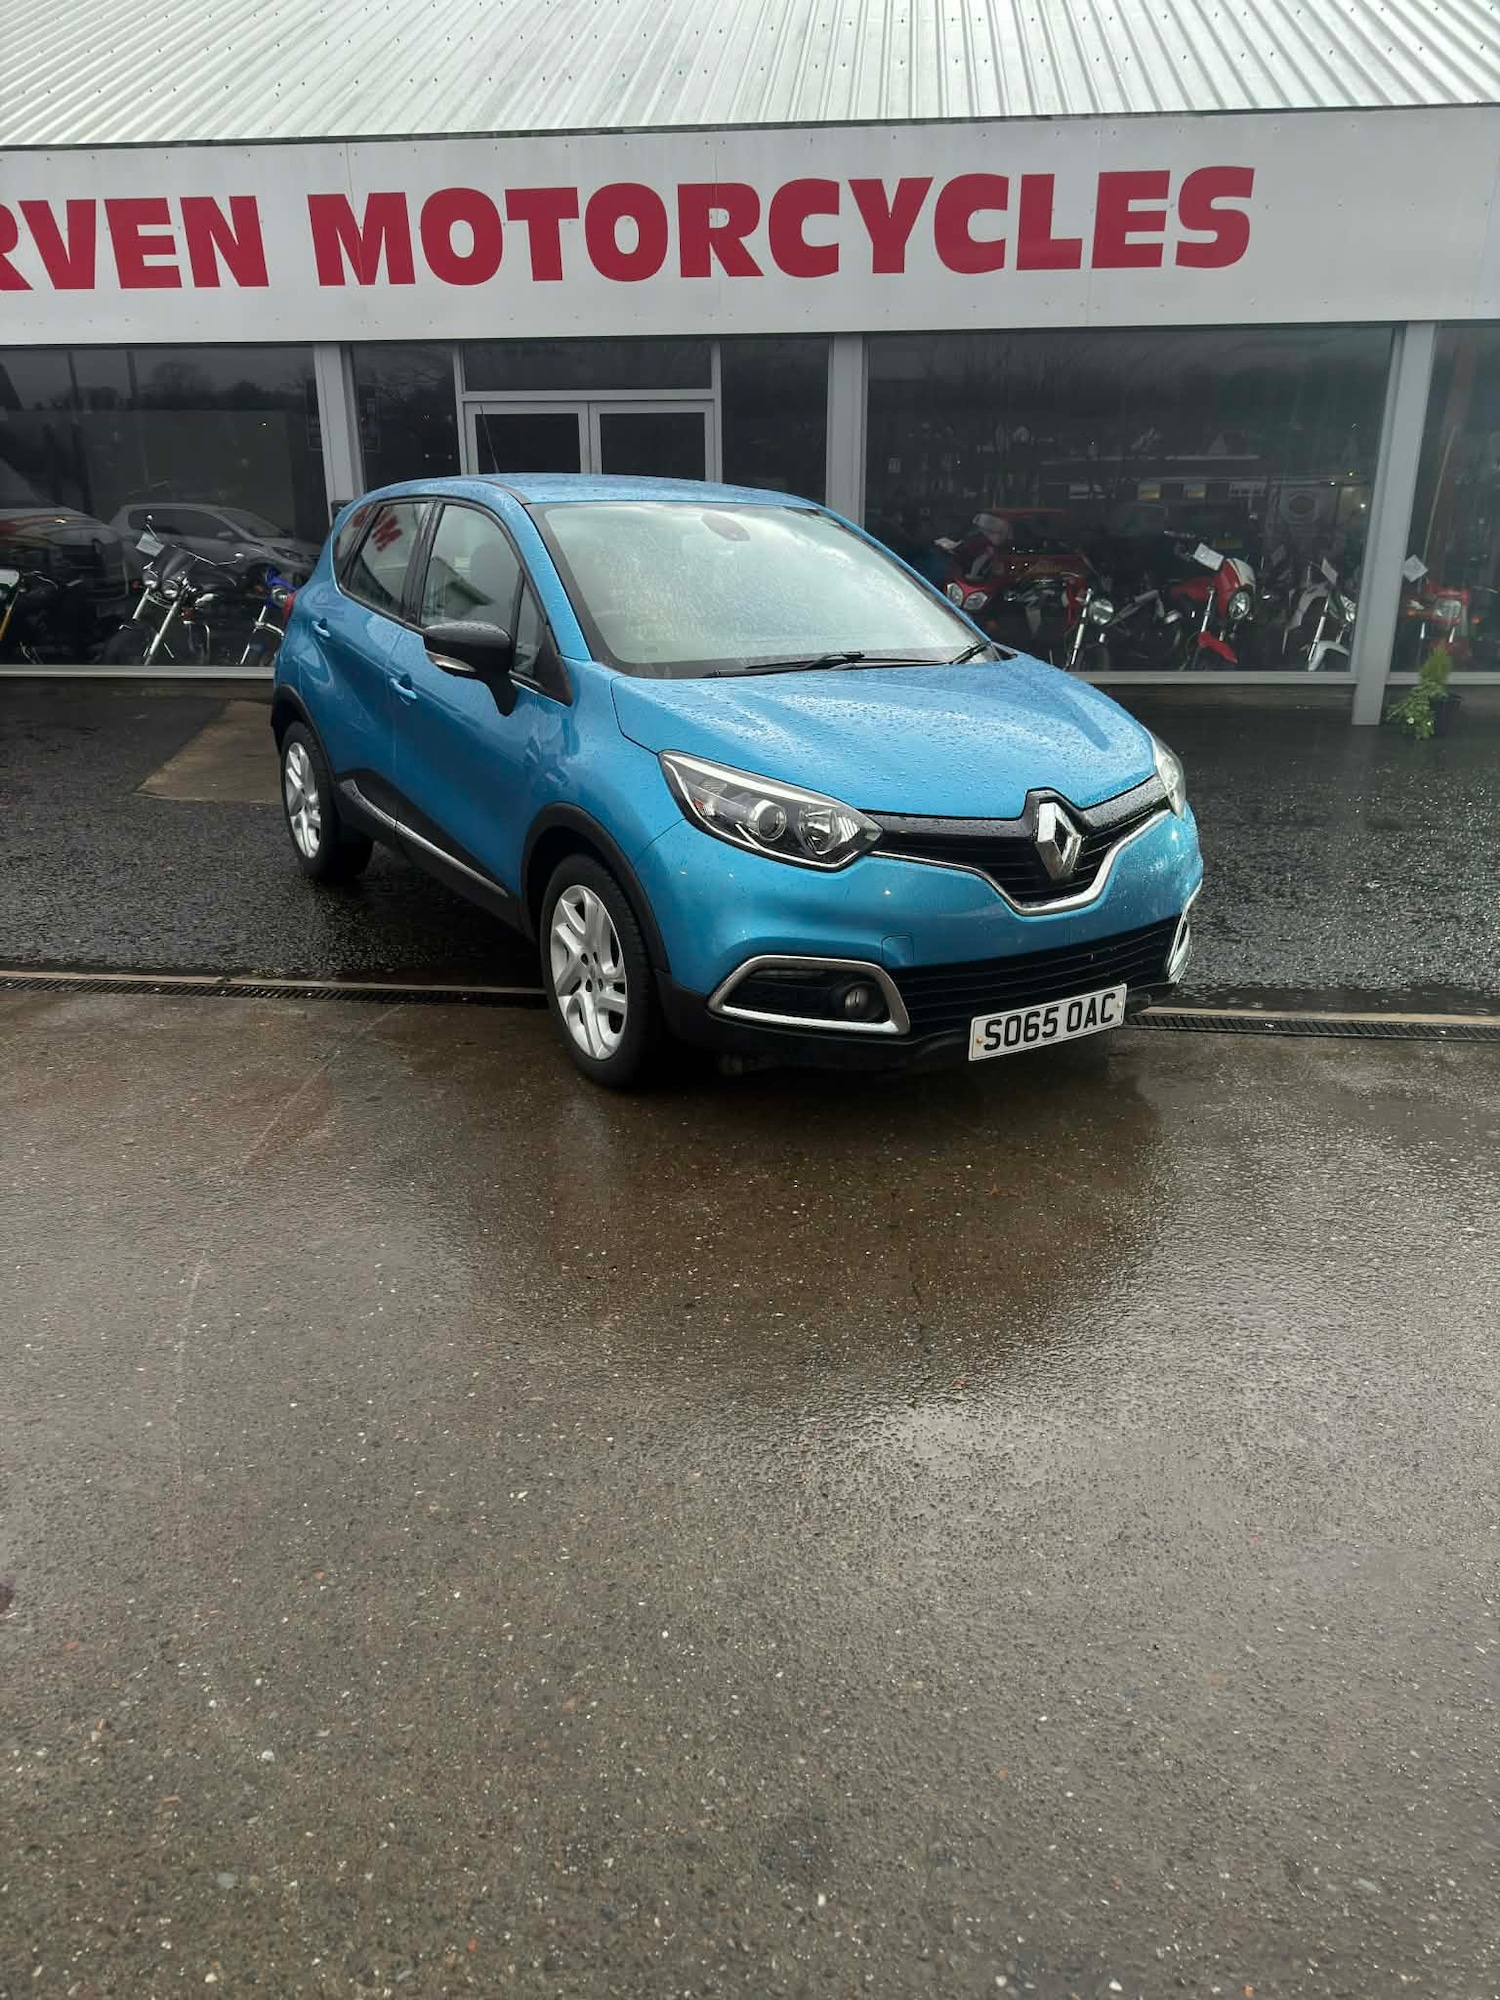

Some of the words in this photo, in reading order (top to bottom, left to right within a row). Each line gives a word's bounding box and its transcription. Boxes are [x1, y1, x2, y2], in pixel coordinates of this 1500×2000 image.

[308, 166, 1254, 287] MOTORCYCLES
[983, 1007, 1060, 1050] SO65
[1066, 992, 1116, 1033] OAC
